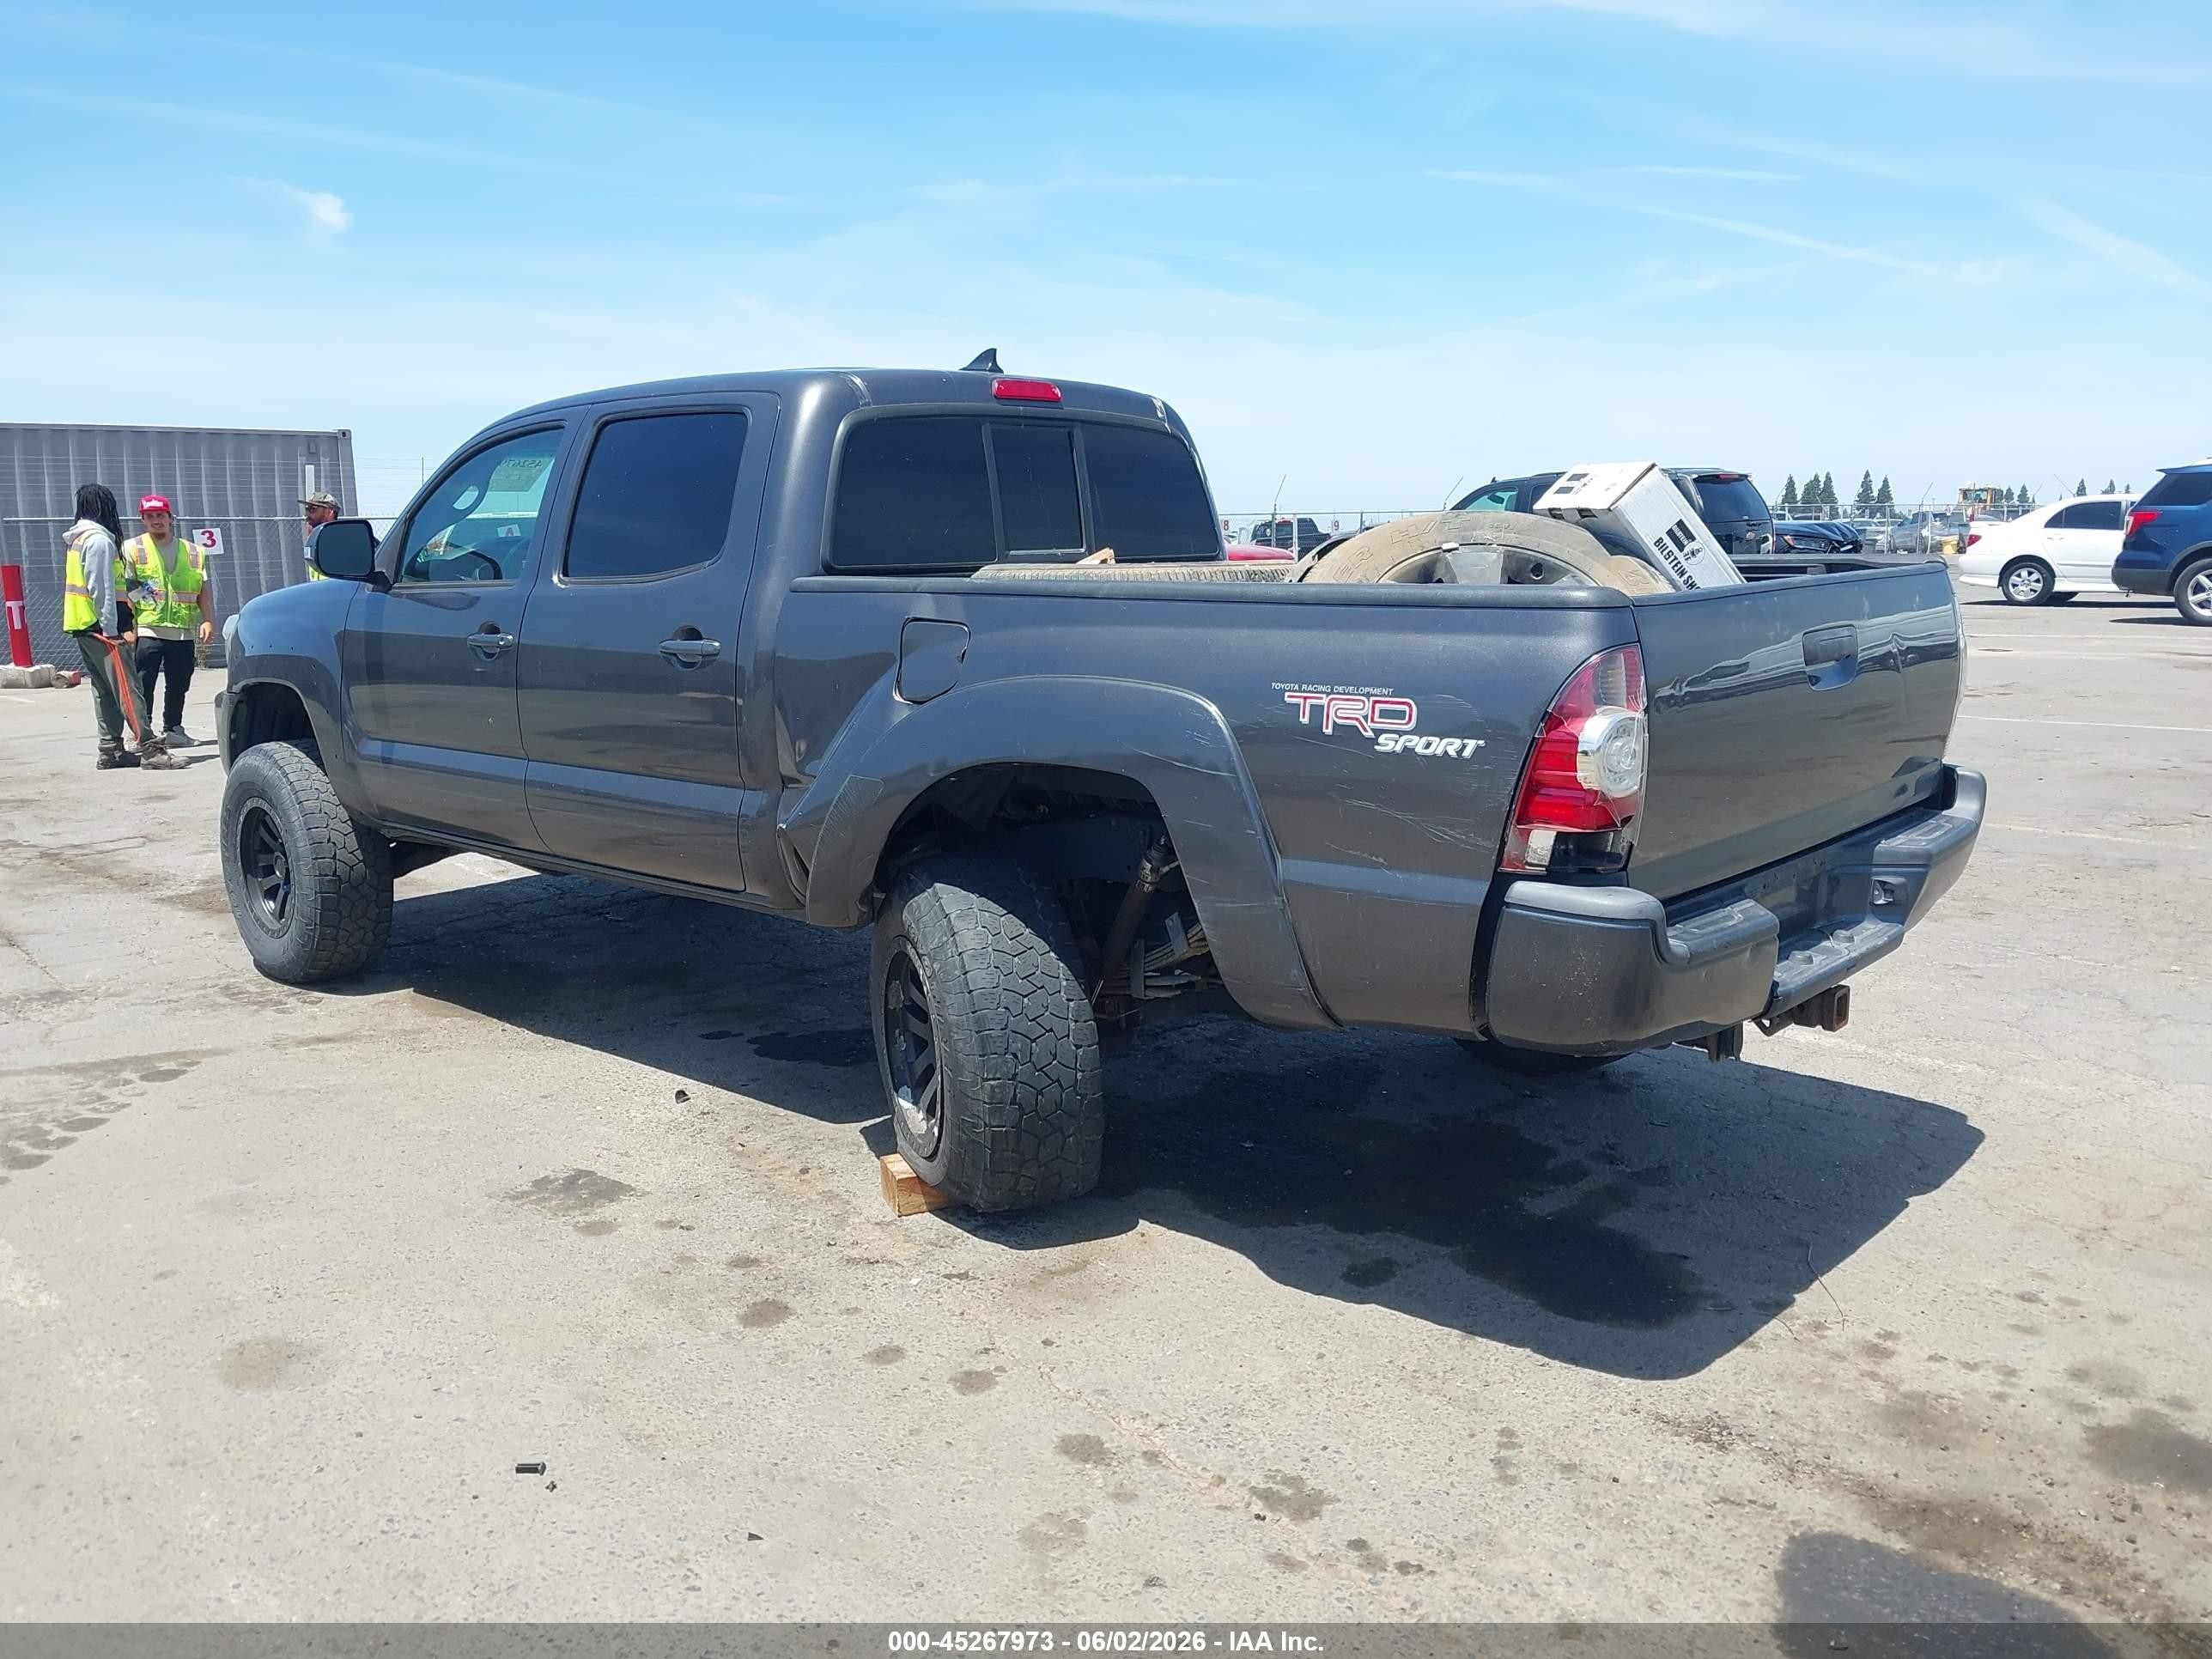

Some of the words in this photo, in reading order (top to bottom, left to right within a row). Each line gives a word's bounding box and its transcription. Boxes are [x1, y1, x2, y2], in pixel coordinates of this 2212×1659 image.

[1223, 520, 1230, 531] 8
[1334, 520, 1339, 531] 9
[1671, 524, 1689, 546] BILSTEIN
[200, 530, 216, 548] 3
[1653, 536, 1688, 579] BILSTEIN
[1271, 683, 1299, 691] TOYOTA
[1334, 685, 1395, 696] DEVELOPMENT
[1285, 692, 1417, 738] TRD
[1374, 733, 1486, 759] SPORT
